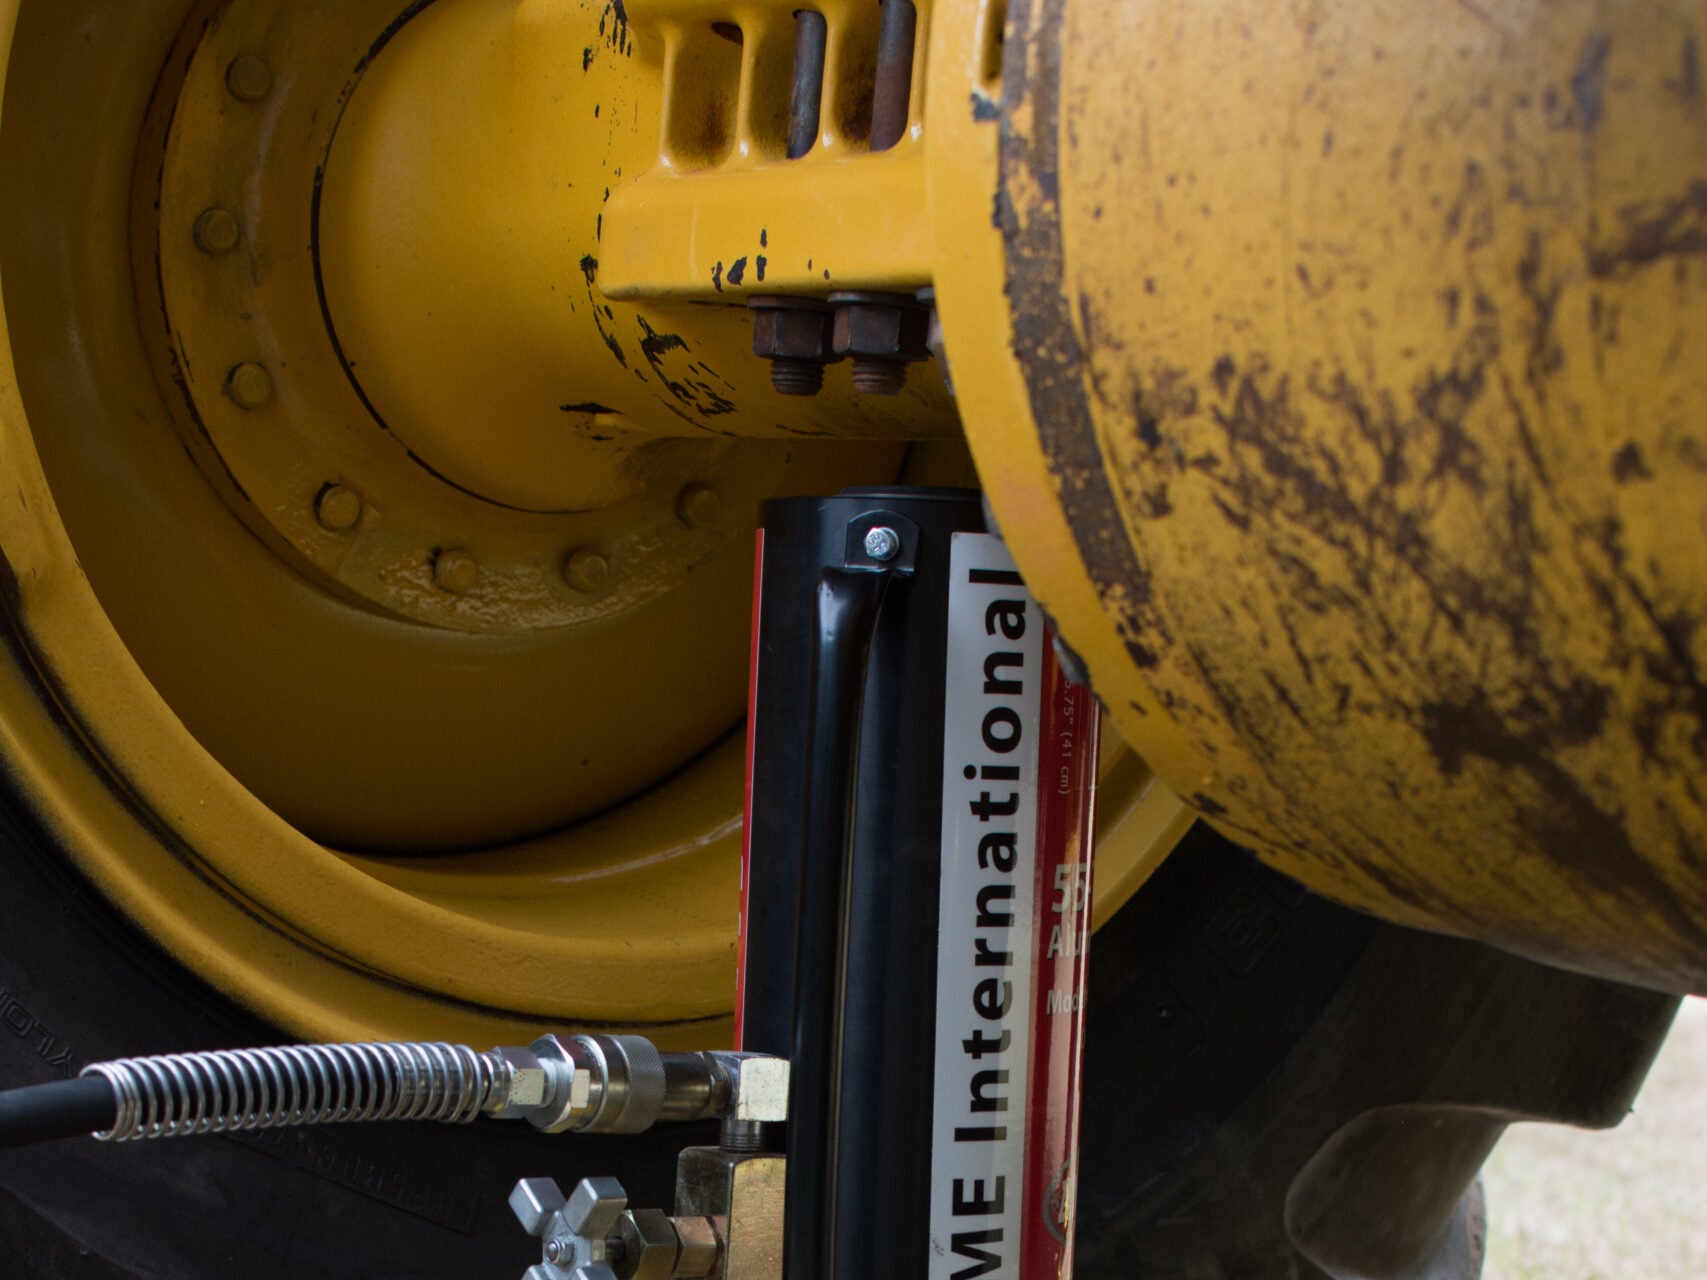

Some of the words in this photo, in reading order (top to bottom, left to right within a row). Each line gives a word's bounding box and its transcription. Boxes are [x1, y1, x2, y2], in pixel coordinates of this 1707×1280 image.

[1059, 731, 1073, 758] (41
[1057, 766, 1071, 795] cm)
[953, 567, 1027, 1142] International
[1046, 921, 1092, 960] Alu
